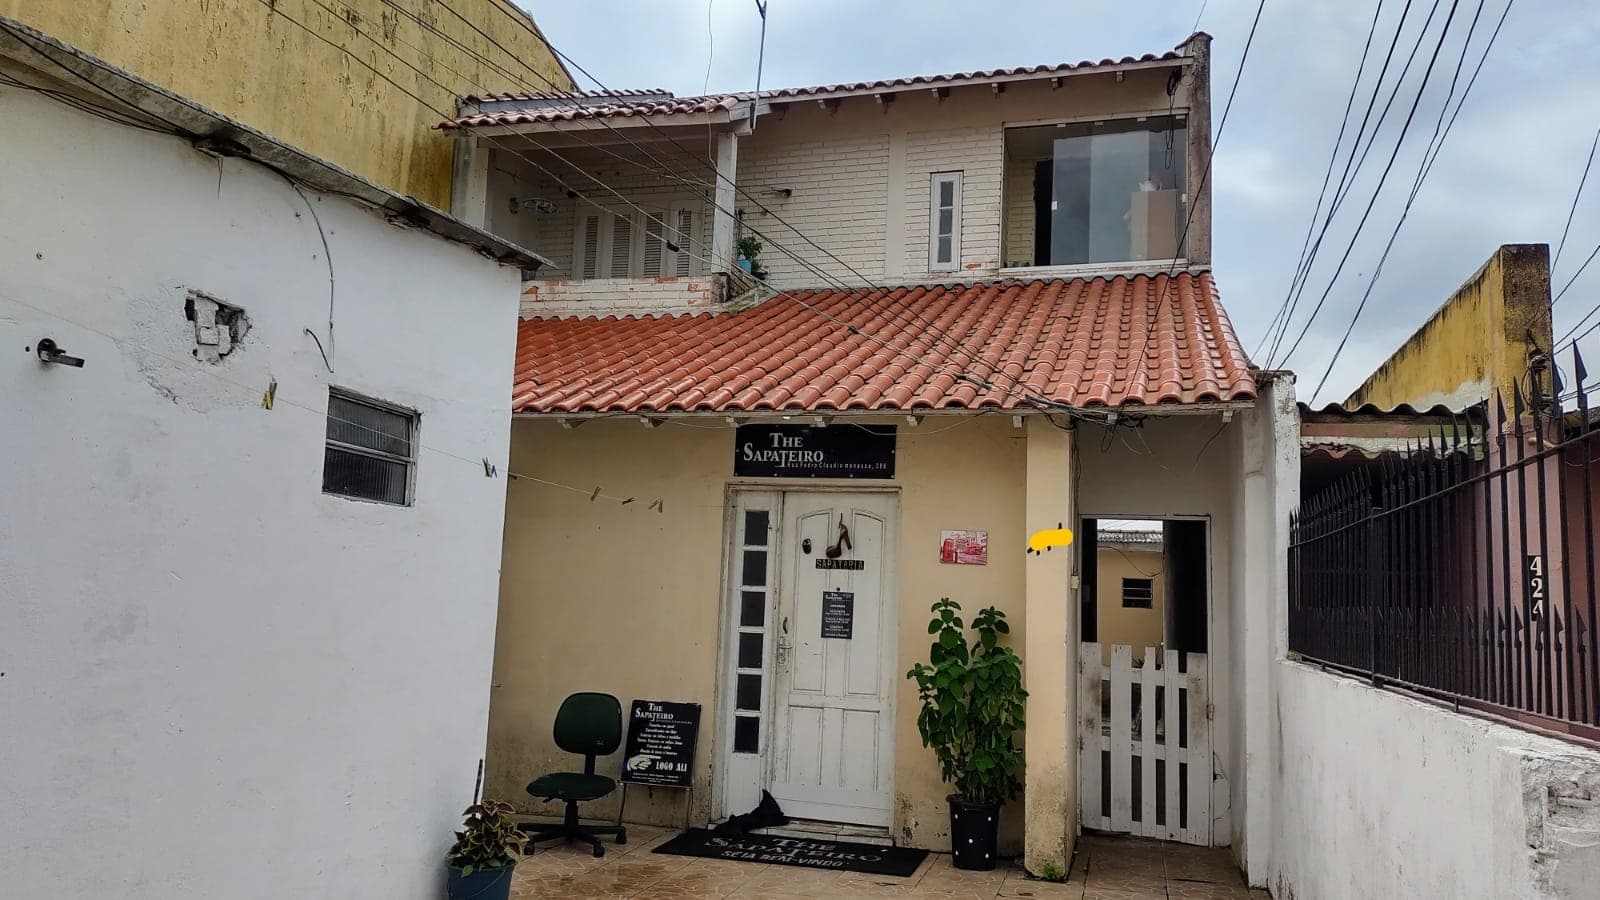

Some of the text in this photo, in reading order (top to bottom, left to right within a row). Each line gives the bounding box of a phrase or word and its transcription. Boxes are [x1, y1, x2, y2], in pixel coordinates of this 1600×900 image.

[769, 432, 804, 448] THE
[743, 442, 824, 468] SAPATEIRO
[635, 707, 674, 721] SAPATEIRO
[648, 702, 664, 712] THE
